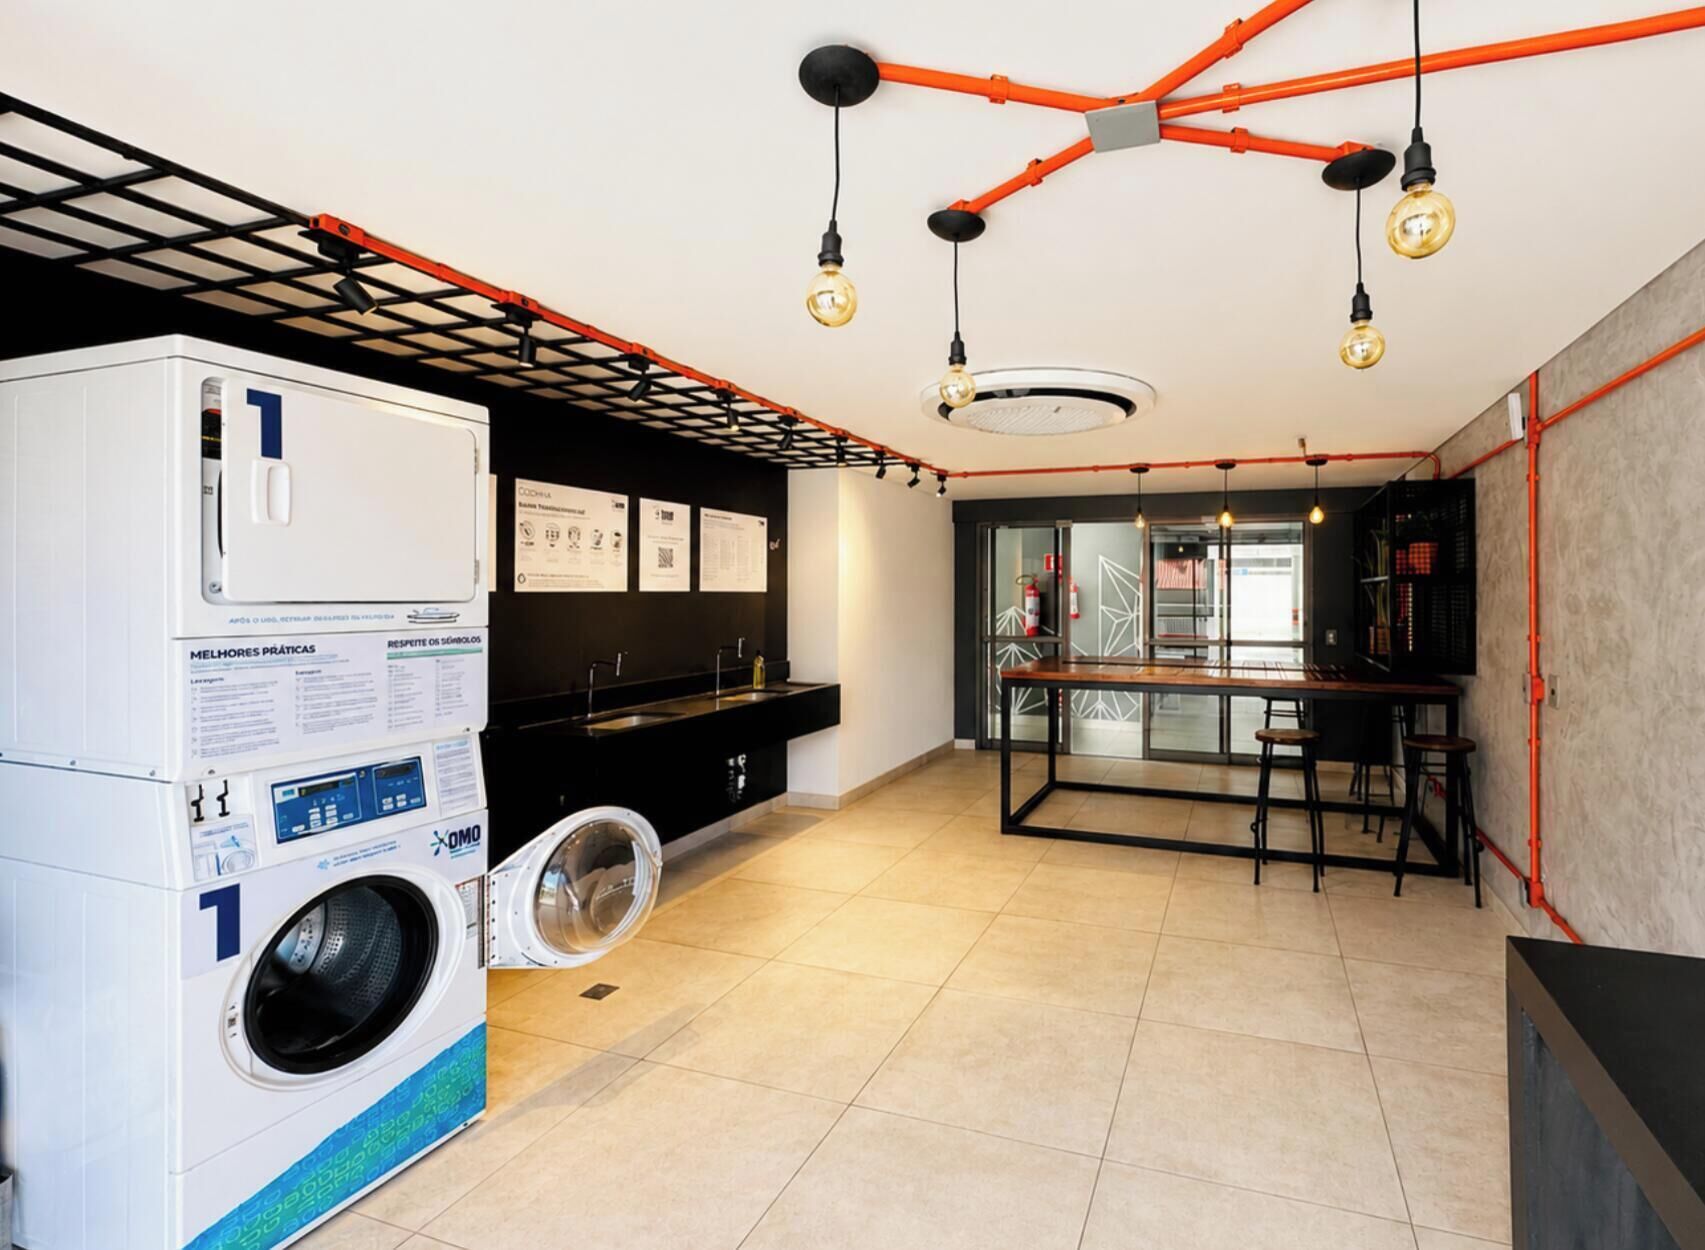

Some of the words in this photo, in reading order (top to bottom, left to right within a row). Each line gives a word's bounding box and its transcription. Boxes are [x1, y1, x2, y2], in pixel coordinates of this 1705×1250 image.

[246, 388, 282, 460] 1
[190, 647, 260, 660] MELHORES
[262, 644, 316, 656] PRÁTICAS
[387, 638, 427, 649] RESPEITE
[429, 637, 440, 647] OS
[448, 824, 481, 849] OMO
[199, 883, 240, 962] 1
